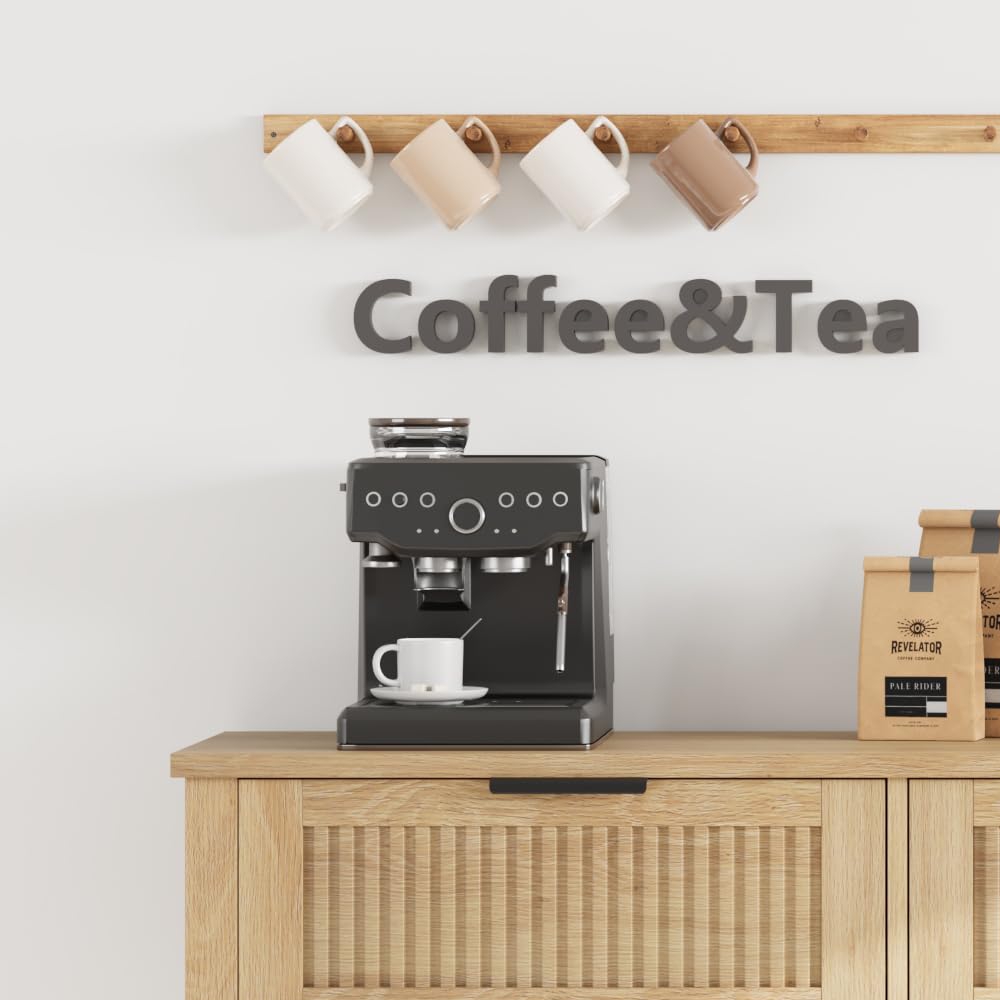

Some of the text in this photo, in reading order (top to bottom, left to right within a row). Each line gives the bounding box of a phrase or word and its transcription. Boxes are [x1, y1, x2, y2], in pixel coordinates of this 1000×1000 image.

[891, 640, 942, 655] REVELATOR
[889, 682, 942, 690] PALE RIDER
